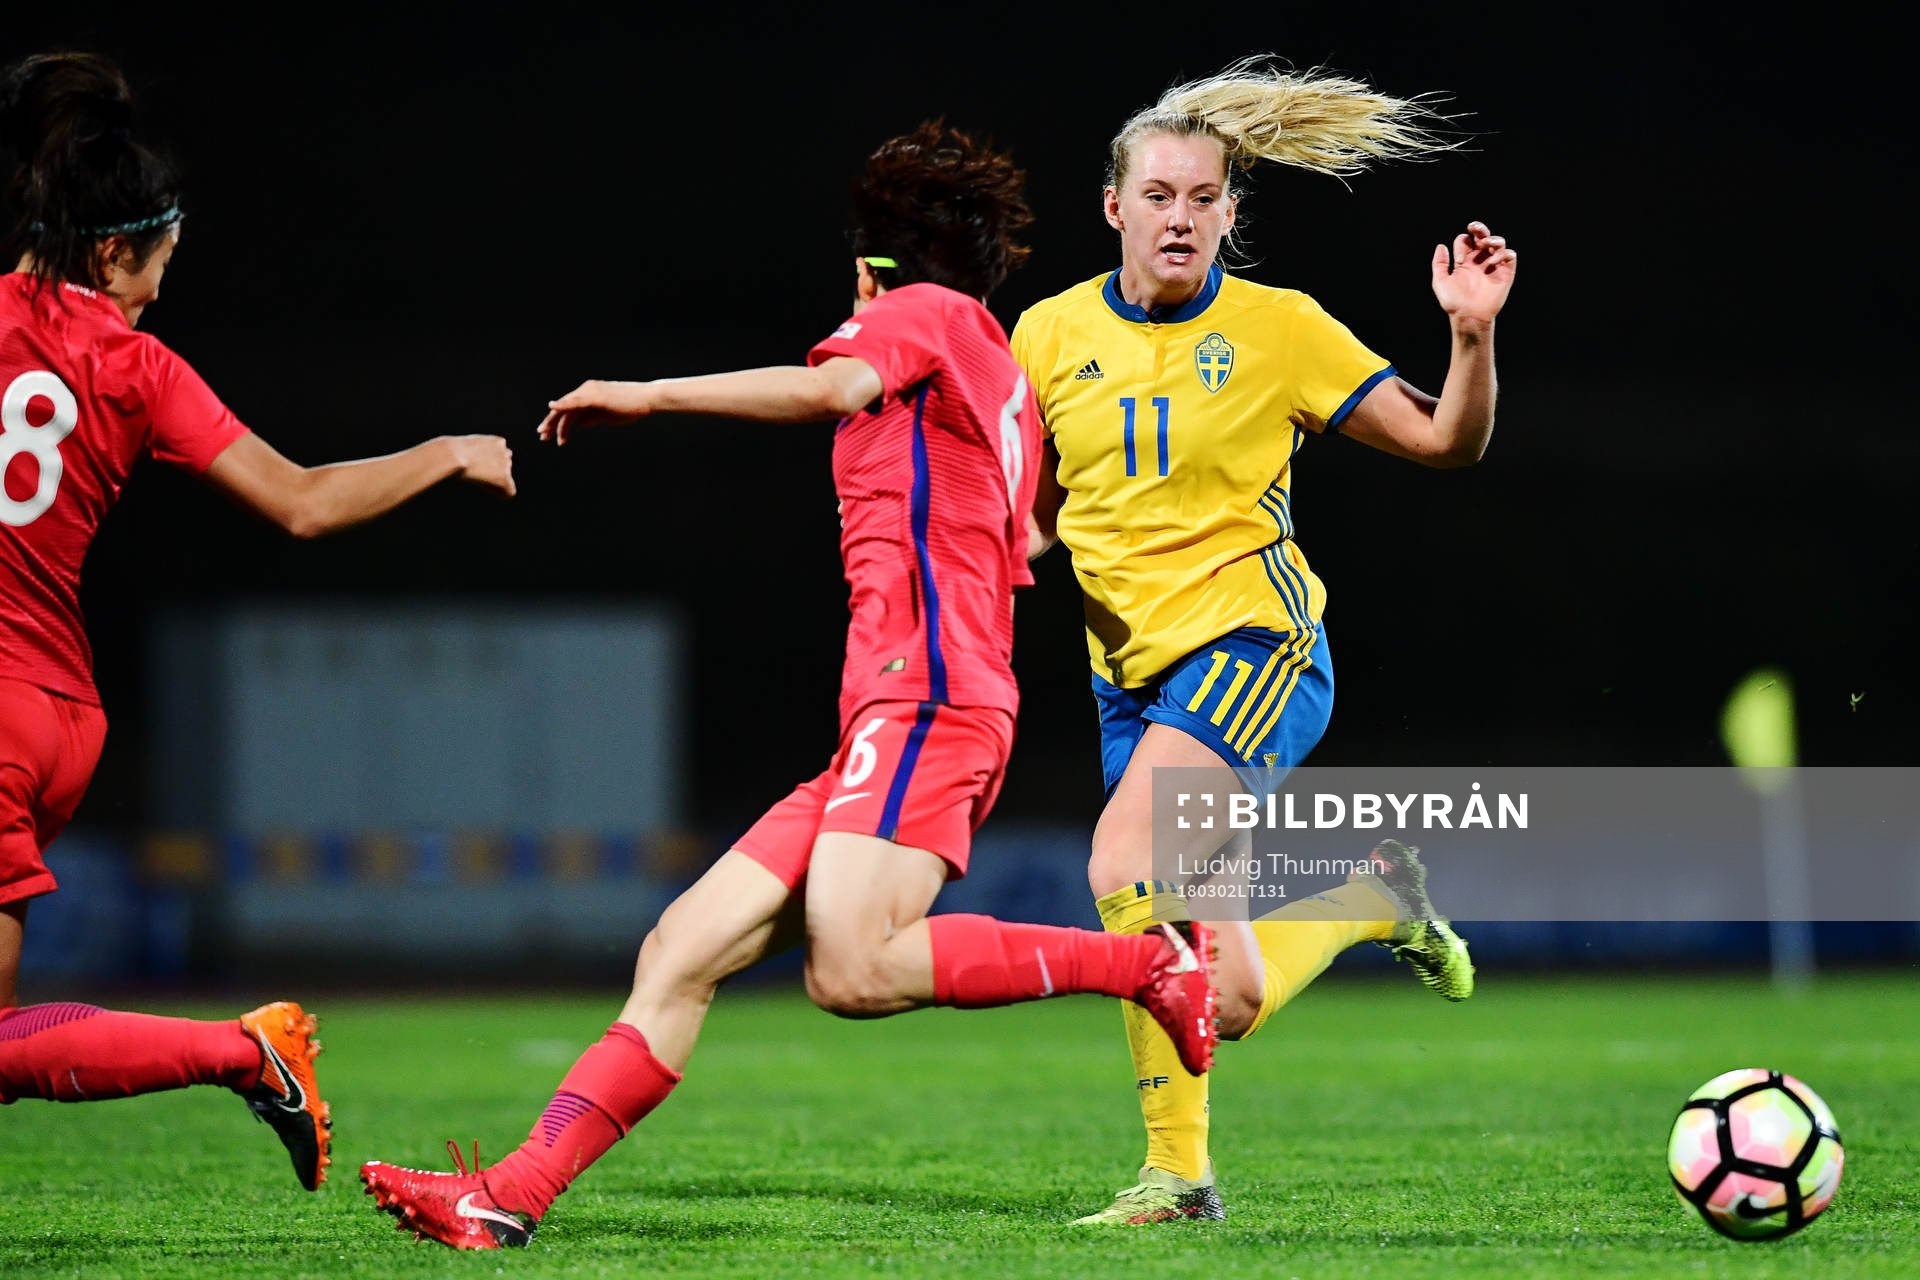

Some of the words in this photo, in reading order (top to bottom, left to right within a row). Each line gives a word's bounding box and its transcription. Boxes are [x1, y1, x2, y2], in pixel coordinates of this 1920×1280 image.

[1075, 371, 1104, 380] adidas
[0, 370, 78, 526] 8
[1119, 397, 1170, 477] 11
[1186, 651, 1254, 726] 11
[843, 718, 886, 788] 6
